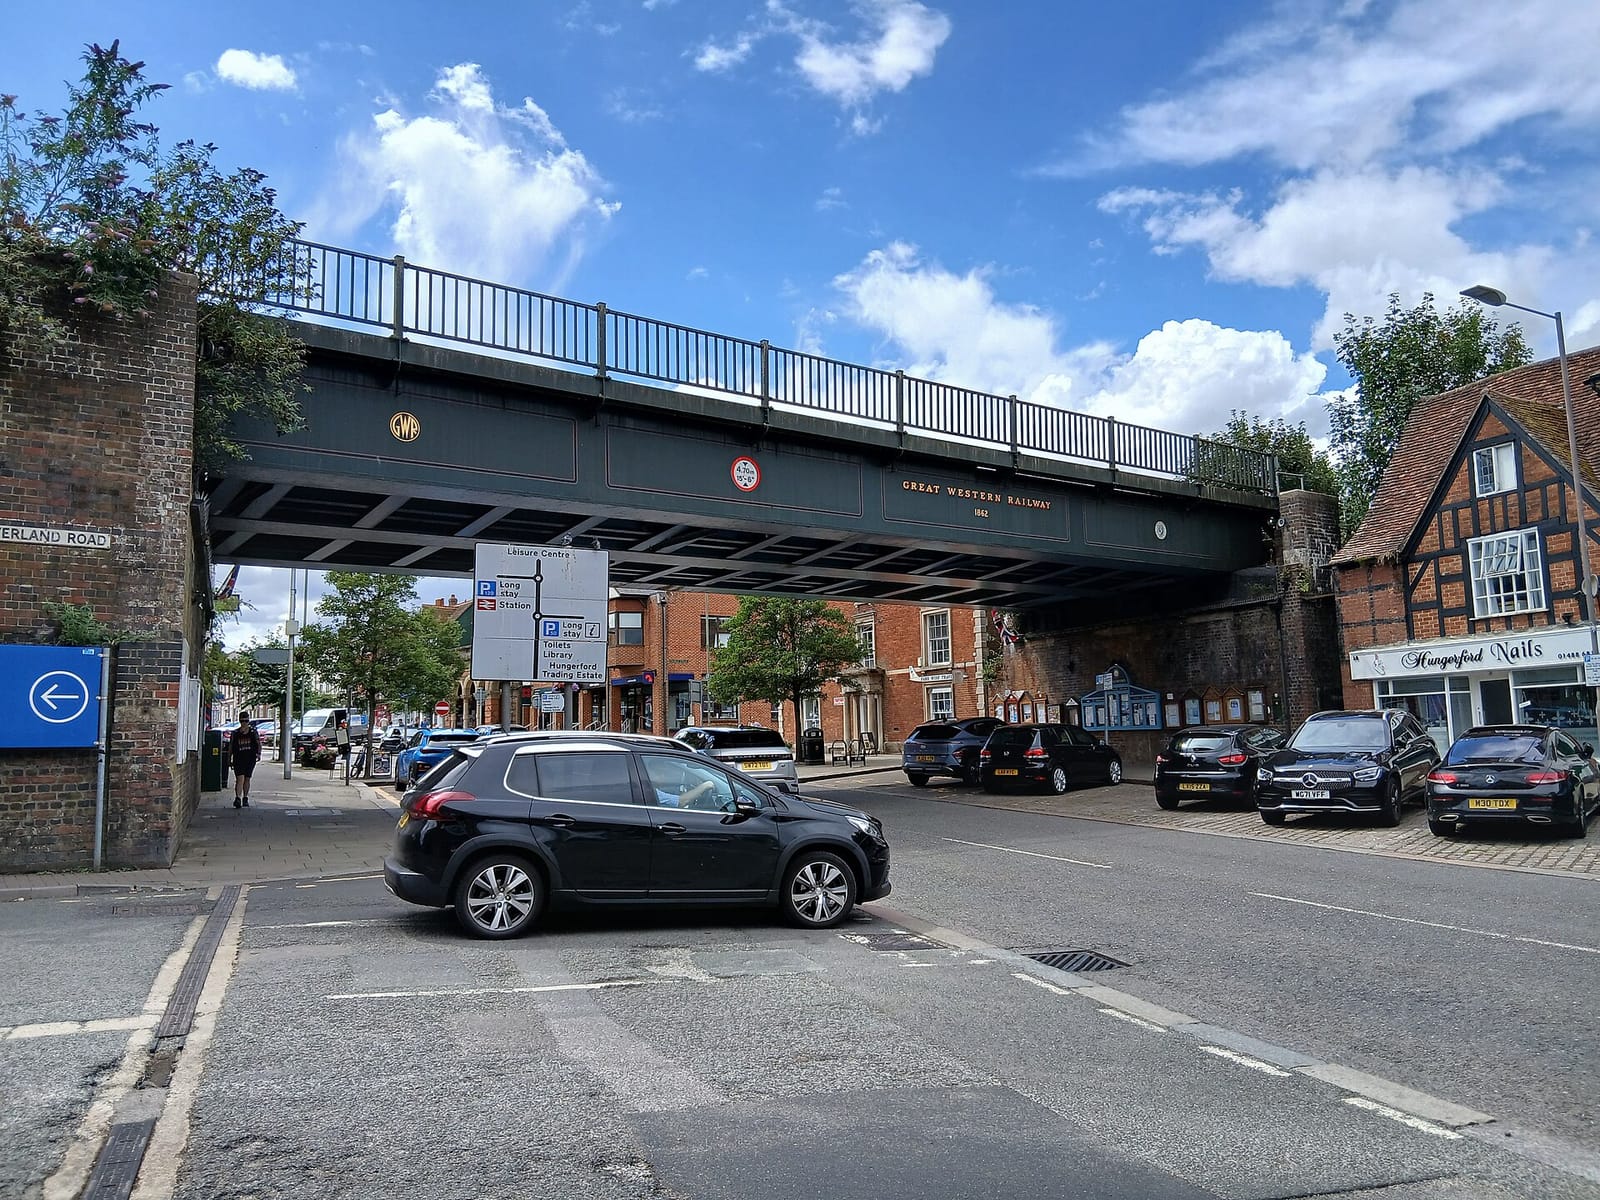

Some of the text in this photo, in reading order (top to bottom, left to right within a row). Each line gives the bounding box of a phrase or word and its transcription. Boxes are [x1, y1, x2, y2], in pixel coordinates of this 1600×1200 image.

[392, 413, 418, 439] GWR
[902, 481, 1051, 510] GREAT WESTERN RAILWAY
[974, 508, 989, 518] 1862
[0, 527, 106, 546] ERLAND ROAD
[507, 548, 570, 559] Leisure Centre
[500, 581, 521, 590] Long
[500, 590, 519, 599] stay
[499, 601, 531, 610] Station
[562, 621, 583, 630] Long
[563, 630, 581, 639] stay
[543, 641, 571, 649] Toilets
[543, 651, 573, 660] Library
[1401, 639, 1543, 670] Hungerford Nails
[549, 662, 597, 671] Hungerford
[542, 670, 603, 680] Trading Estate
